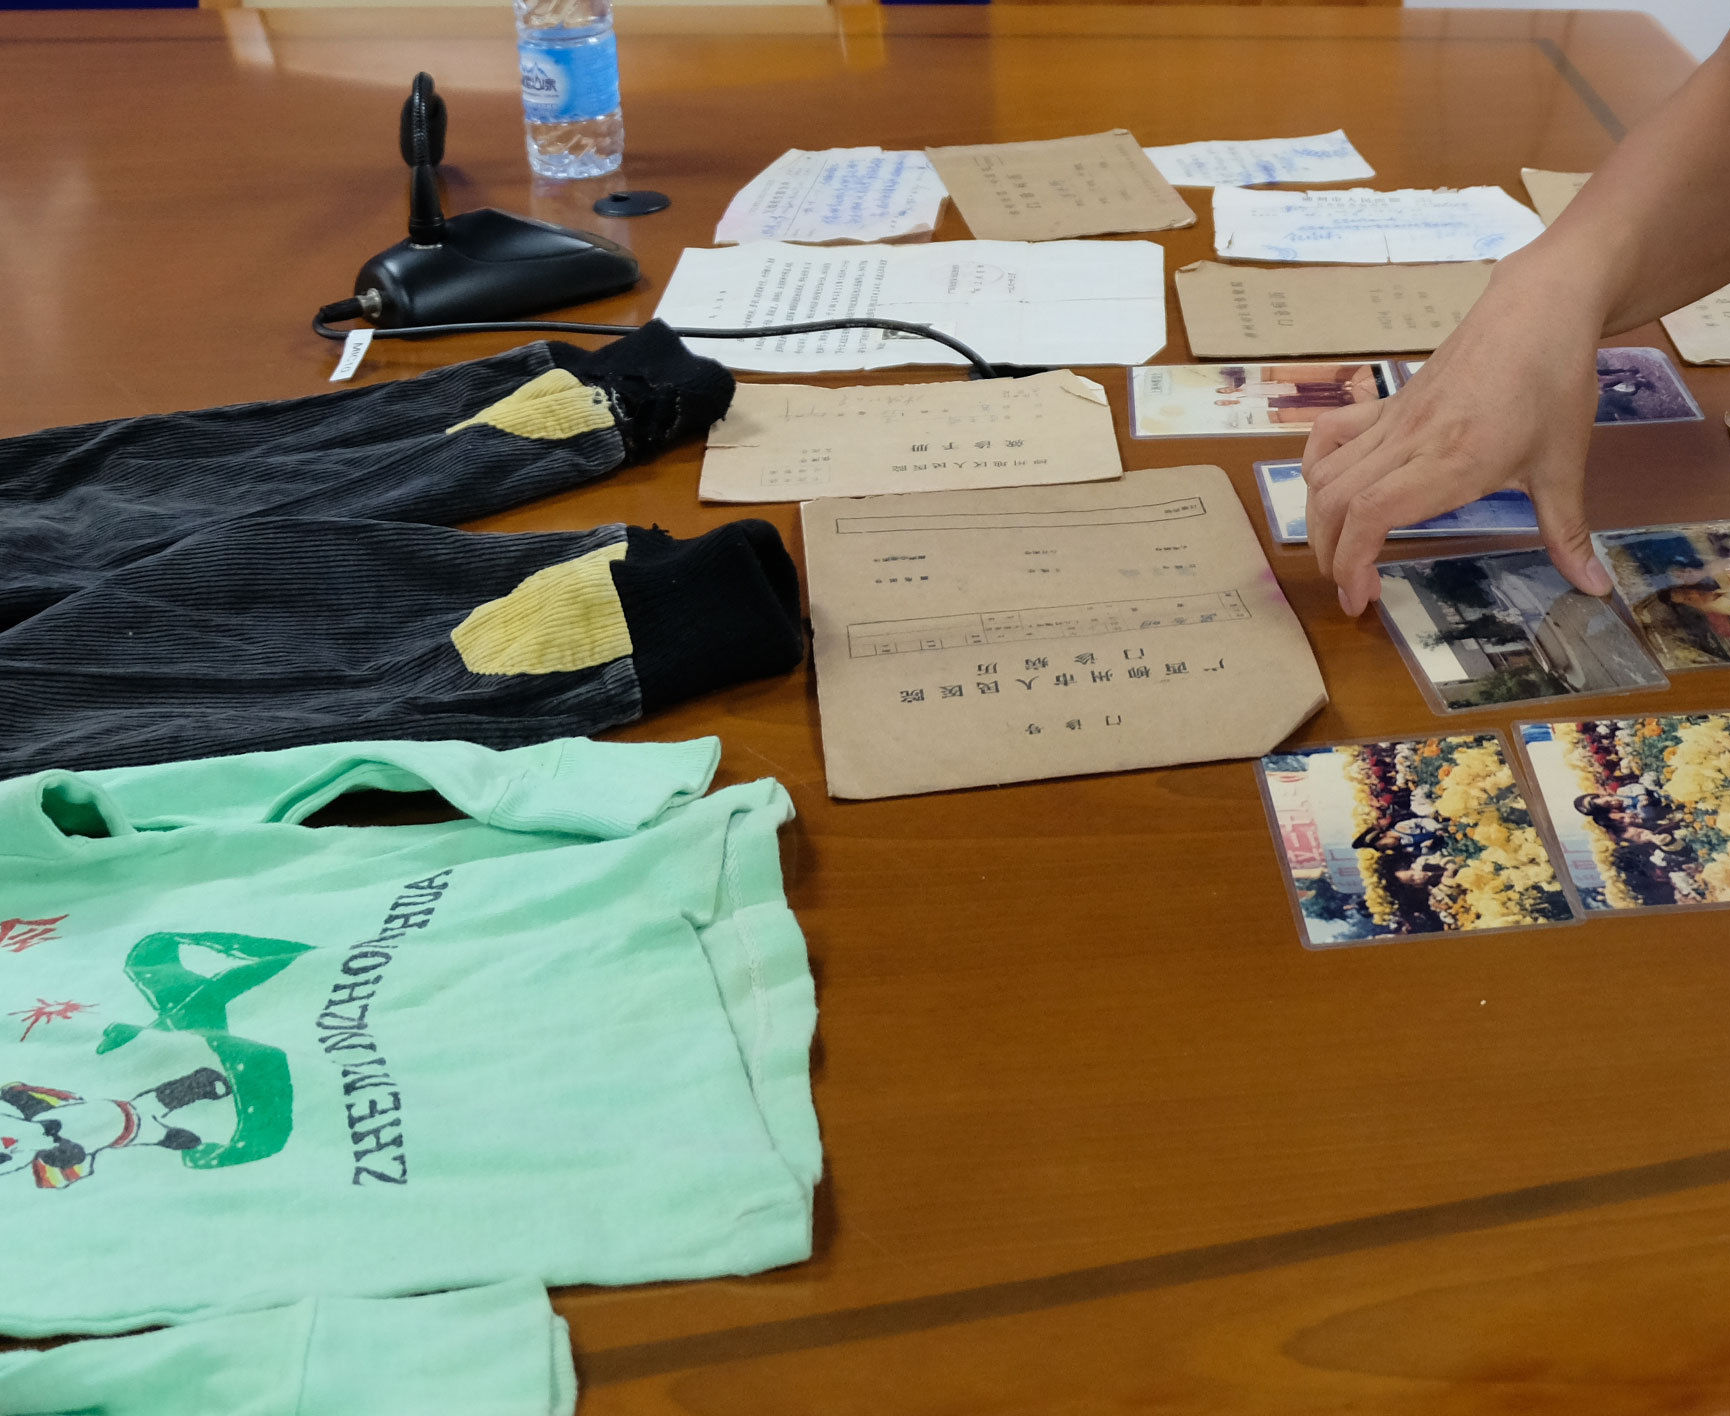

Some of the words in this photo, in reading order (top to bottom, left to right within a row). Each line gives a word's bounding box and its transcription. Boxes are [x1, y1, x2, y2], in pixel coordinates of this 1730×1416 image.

[976, 647, 1145, 676] 门诊病历
[900, 658, 1225, 703] 广西柳州市人民医院
